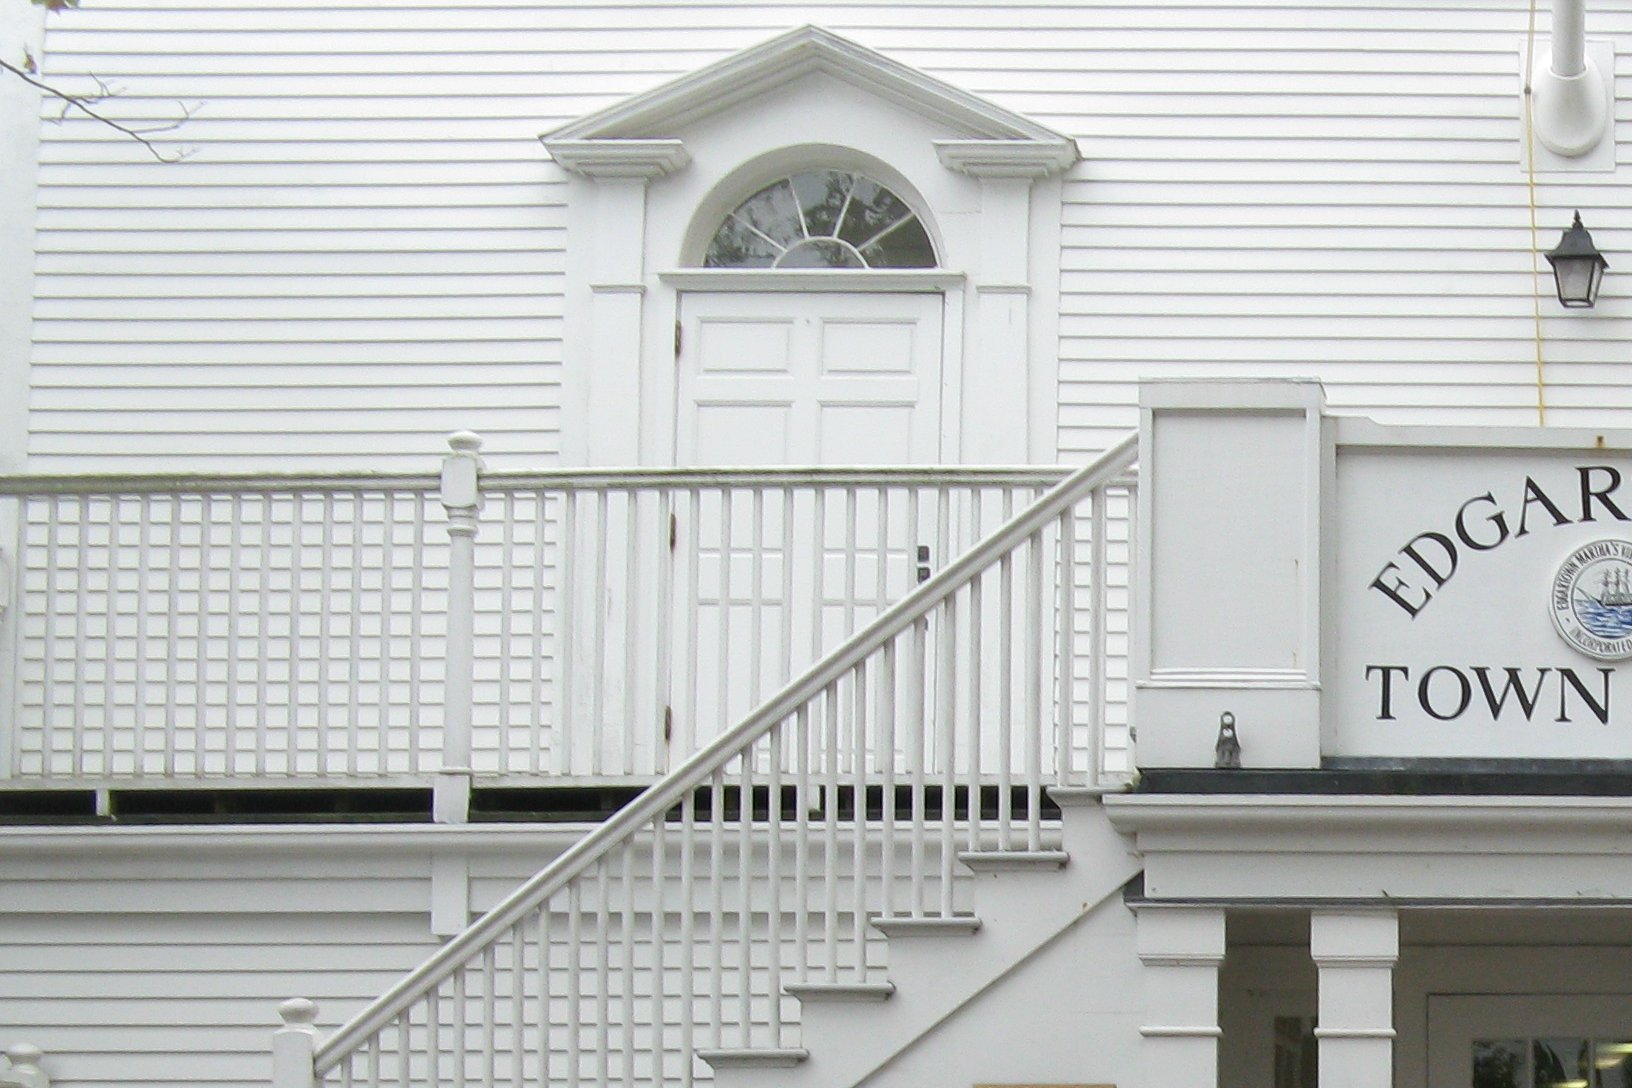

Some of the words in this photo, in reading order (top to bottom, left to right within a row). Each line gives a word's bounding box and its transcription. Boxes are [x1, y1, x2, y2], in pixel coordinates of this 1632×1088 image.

[1556, 561, 1580, 611] EDGARTOWN
[1575, 541, 1619, 567] MARTHA'S
[1569, 626, 1632, 653] INCORPORATED
[1366, 664, 1617, 725] TOWN
